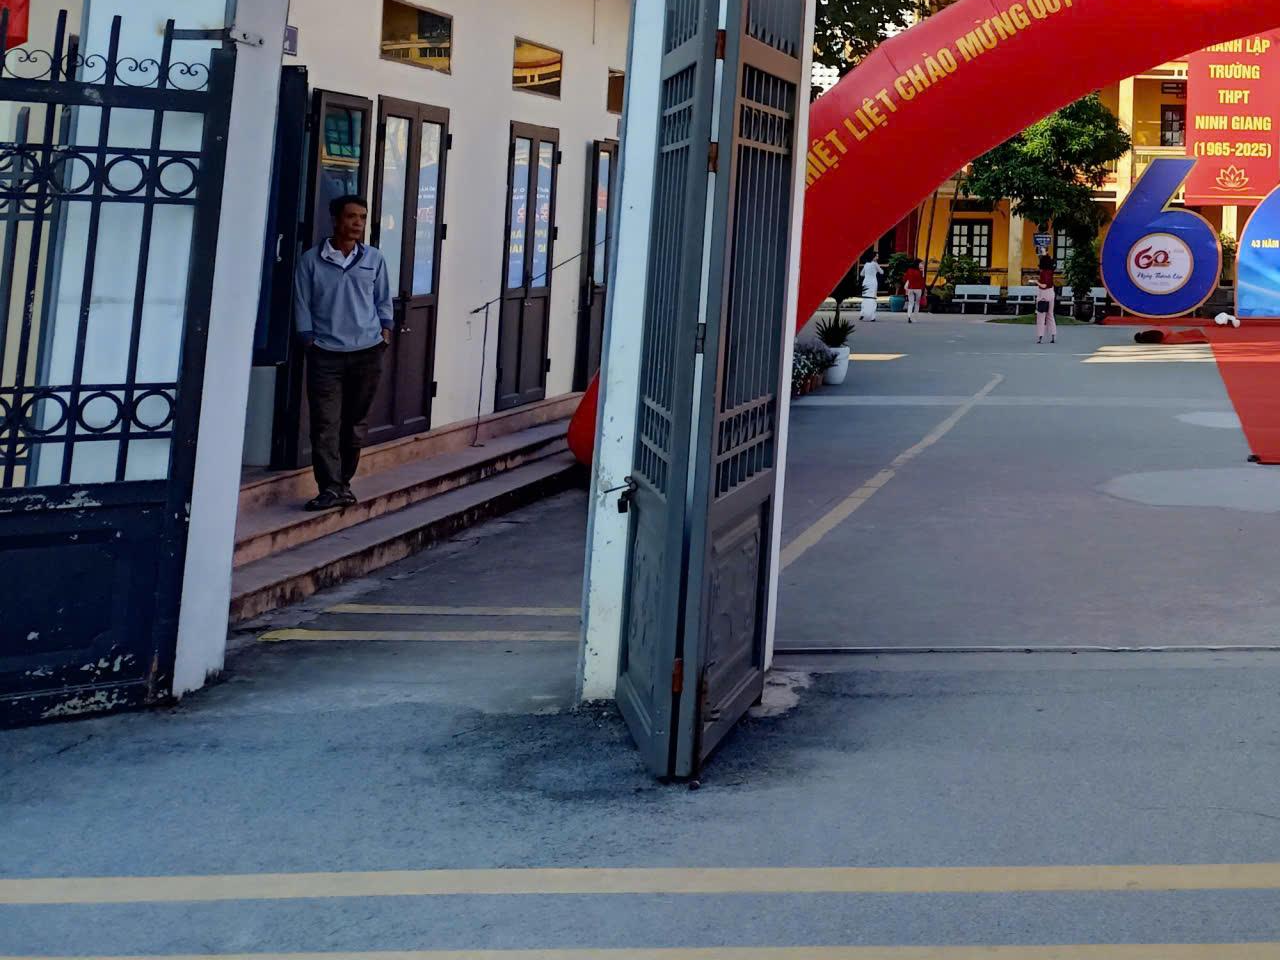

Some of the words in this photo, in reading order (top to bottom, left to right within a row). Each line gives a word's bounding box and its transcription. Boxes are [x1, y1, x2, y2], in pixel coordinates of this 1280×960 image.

[1246, 36, 1270, 56] LẬP
[1209, 61, 1260, 79] TRƯỜNG
[806, 129, 847, 189] HIỆT
[843, 89, 898, 142] LIỆT
[894, 47, 957, 100] CHÀO
[956, 3, 1031, 62] MỪNG
[1218, 90, 1250, 104] THPT
[1195, 115, 1228, 129] NINH
[1231, 117, 1271, 131] GIANG
[1194, 141, 1271, 158] (1965-2025)
[1251, 239, 1260, 248] 43
[1262, 238, 1279, 248] NĂM
